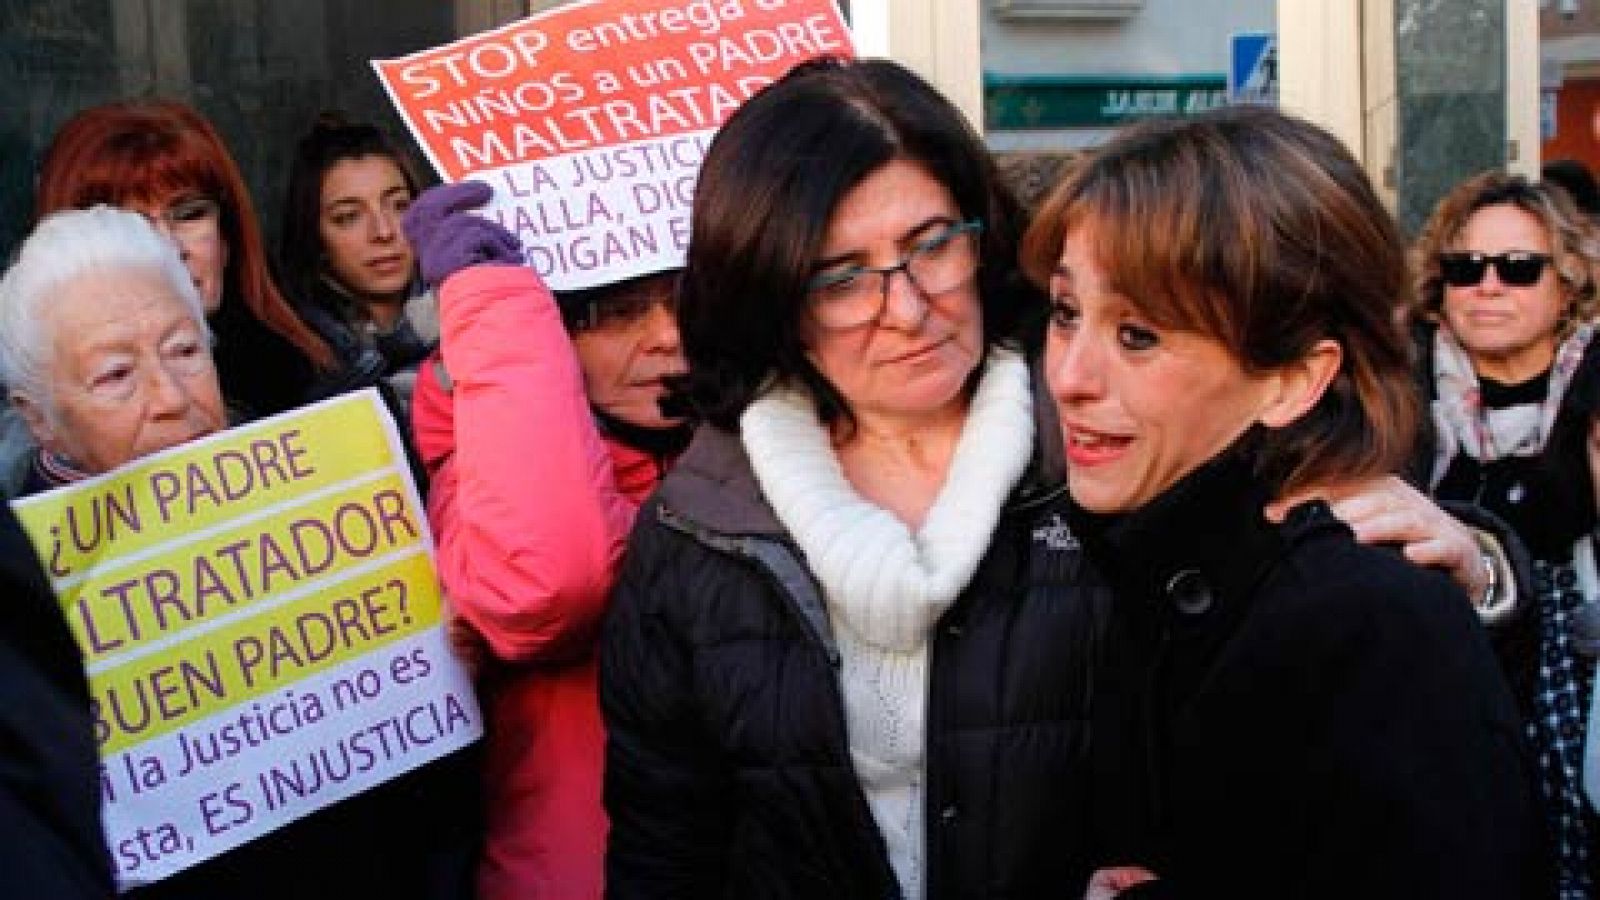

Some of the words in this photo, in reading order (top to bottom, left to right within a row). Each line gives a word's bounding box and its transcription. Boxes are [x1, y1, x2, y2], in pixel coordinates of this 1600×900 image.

[401, 29, 548, 100] STOP
[566, 0, 744, 53] entrega
[423, 72, 583, 134] NIÑOS
[594, 70, 622, 94] a
[628, 57, 688, 90] un
[689, 12, 842, 75] PADRE
[496, 190, 625, 238] ALLA,
[503, 163, 561, 197] LA
[525, 222, 658, 278] DIGAN
[50, 483, 141, 577] ¿UN
[150, 429, 316, 522] PADRE
[79, 488, 418, 654] LTRATADOR
[234, 579, 414, 687] PADRE?
[123, 752, 167, 794] la
[178, 689, 325, 777] Justicia
[332, 667, 382, 710] no
[391, 646, 432, 685] es
[200, 782, 254, 837] ES
[260, 693, 472, 811] INJUSTICIA
